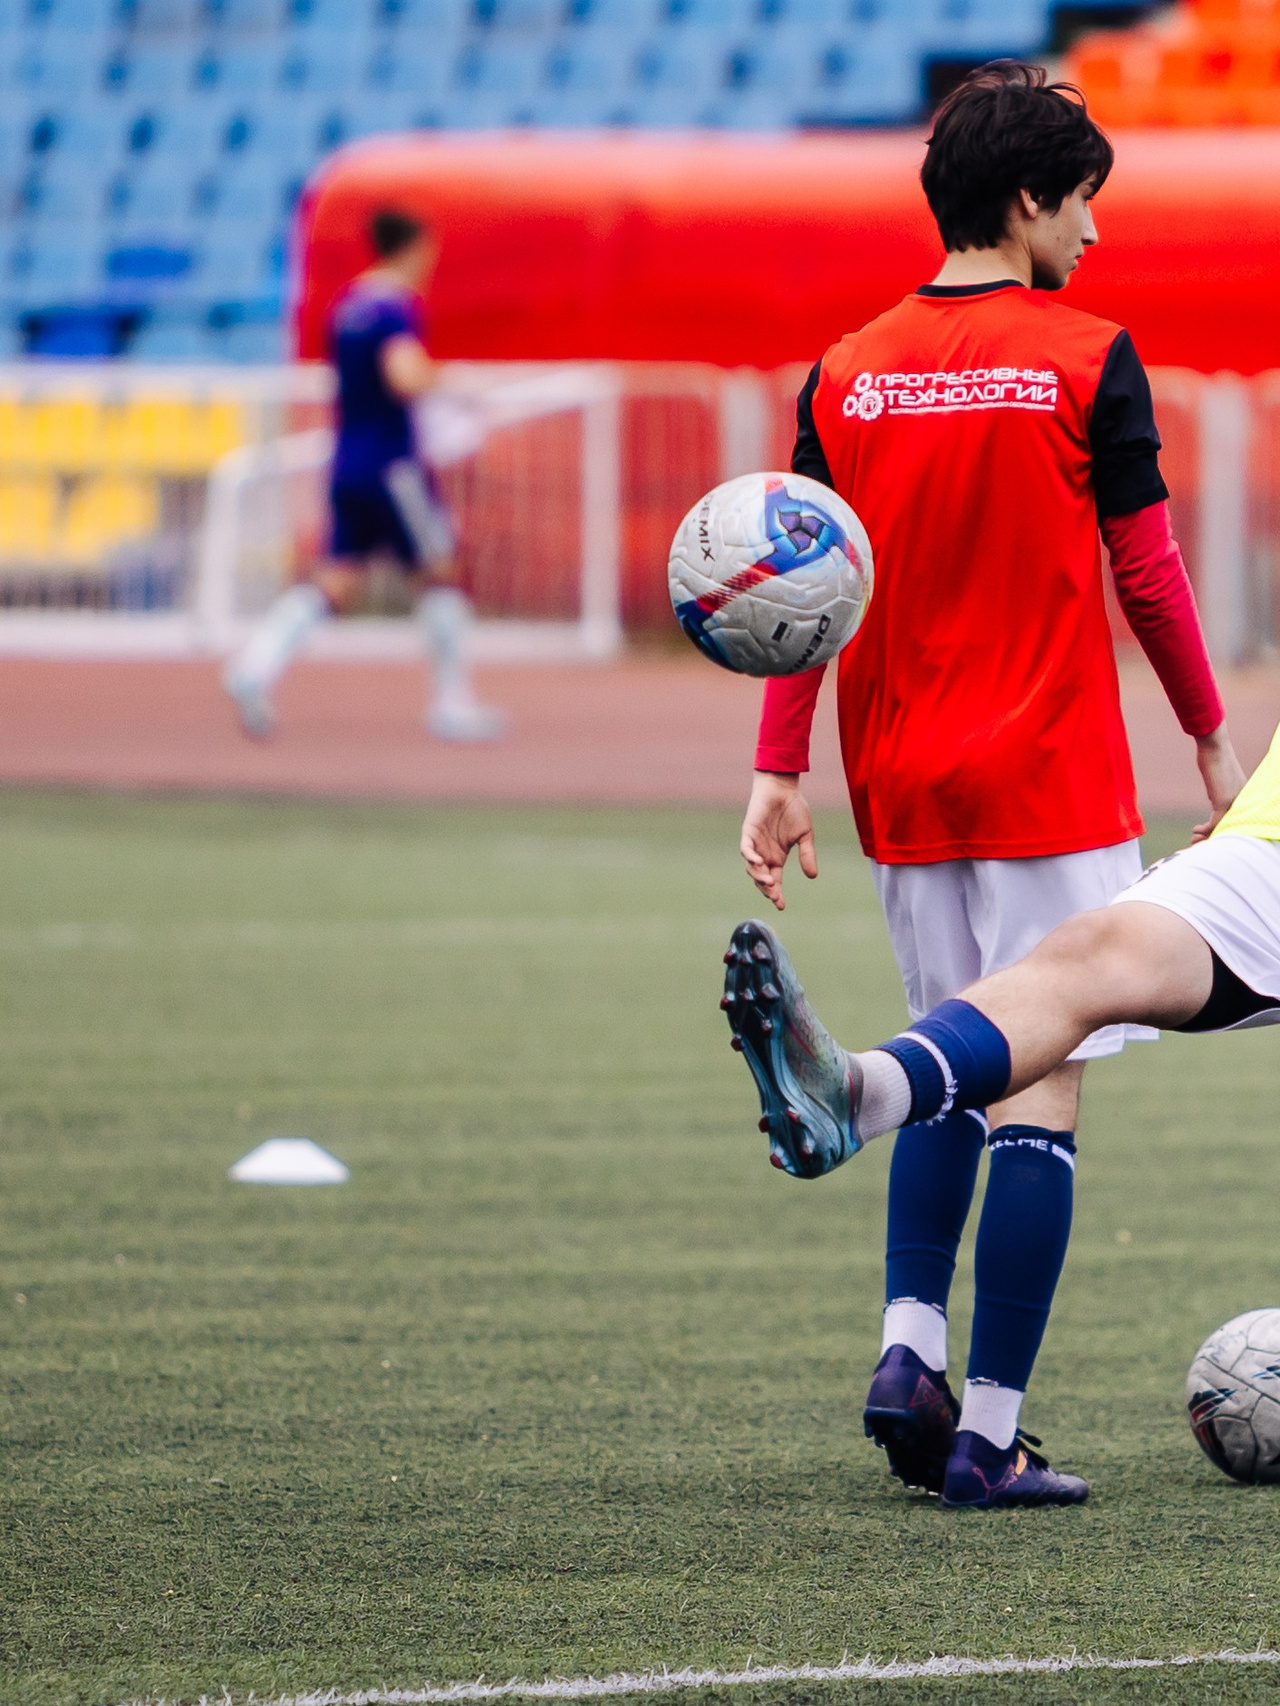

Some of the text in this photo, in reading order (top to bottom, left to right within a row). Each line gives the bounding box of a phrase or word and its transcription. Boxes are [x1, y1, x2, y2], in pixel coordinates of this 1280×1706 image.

[875, 367, 1058, 388] ПРОГРЕССИВНЫЕ
[883, 383, 1058, 406] ТЕХНОЛОГИИ
[790, 614, 832, 672] DEMI
